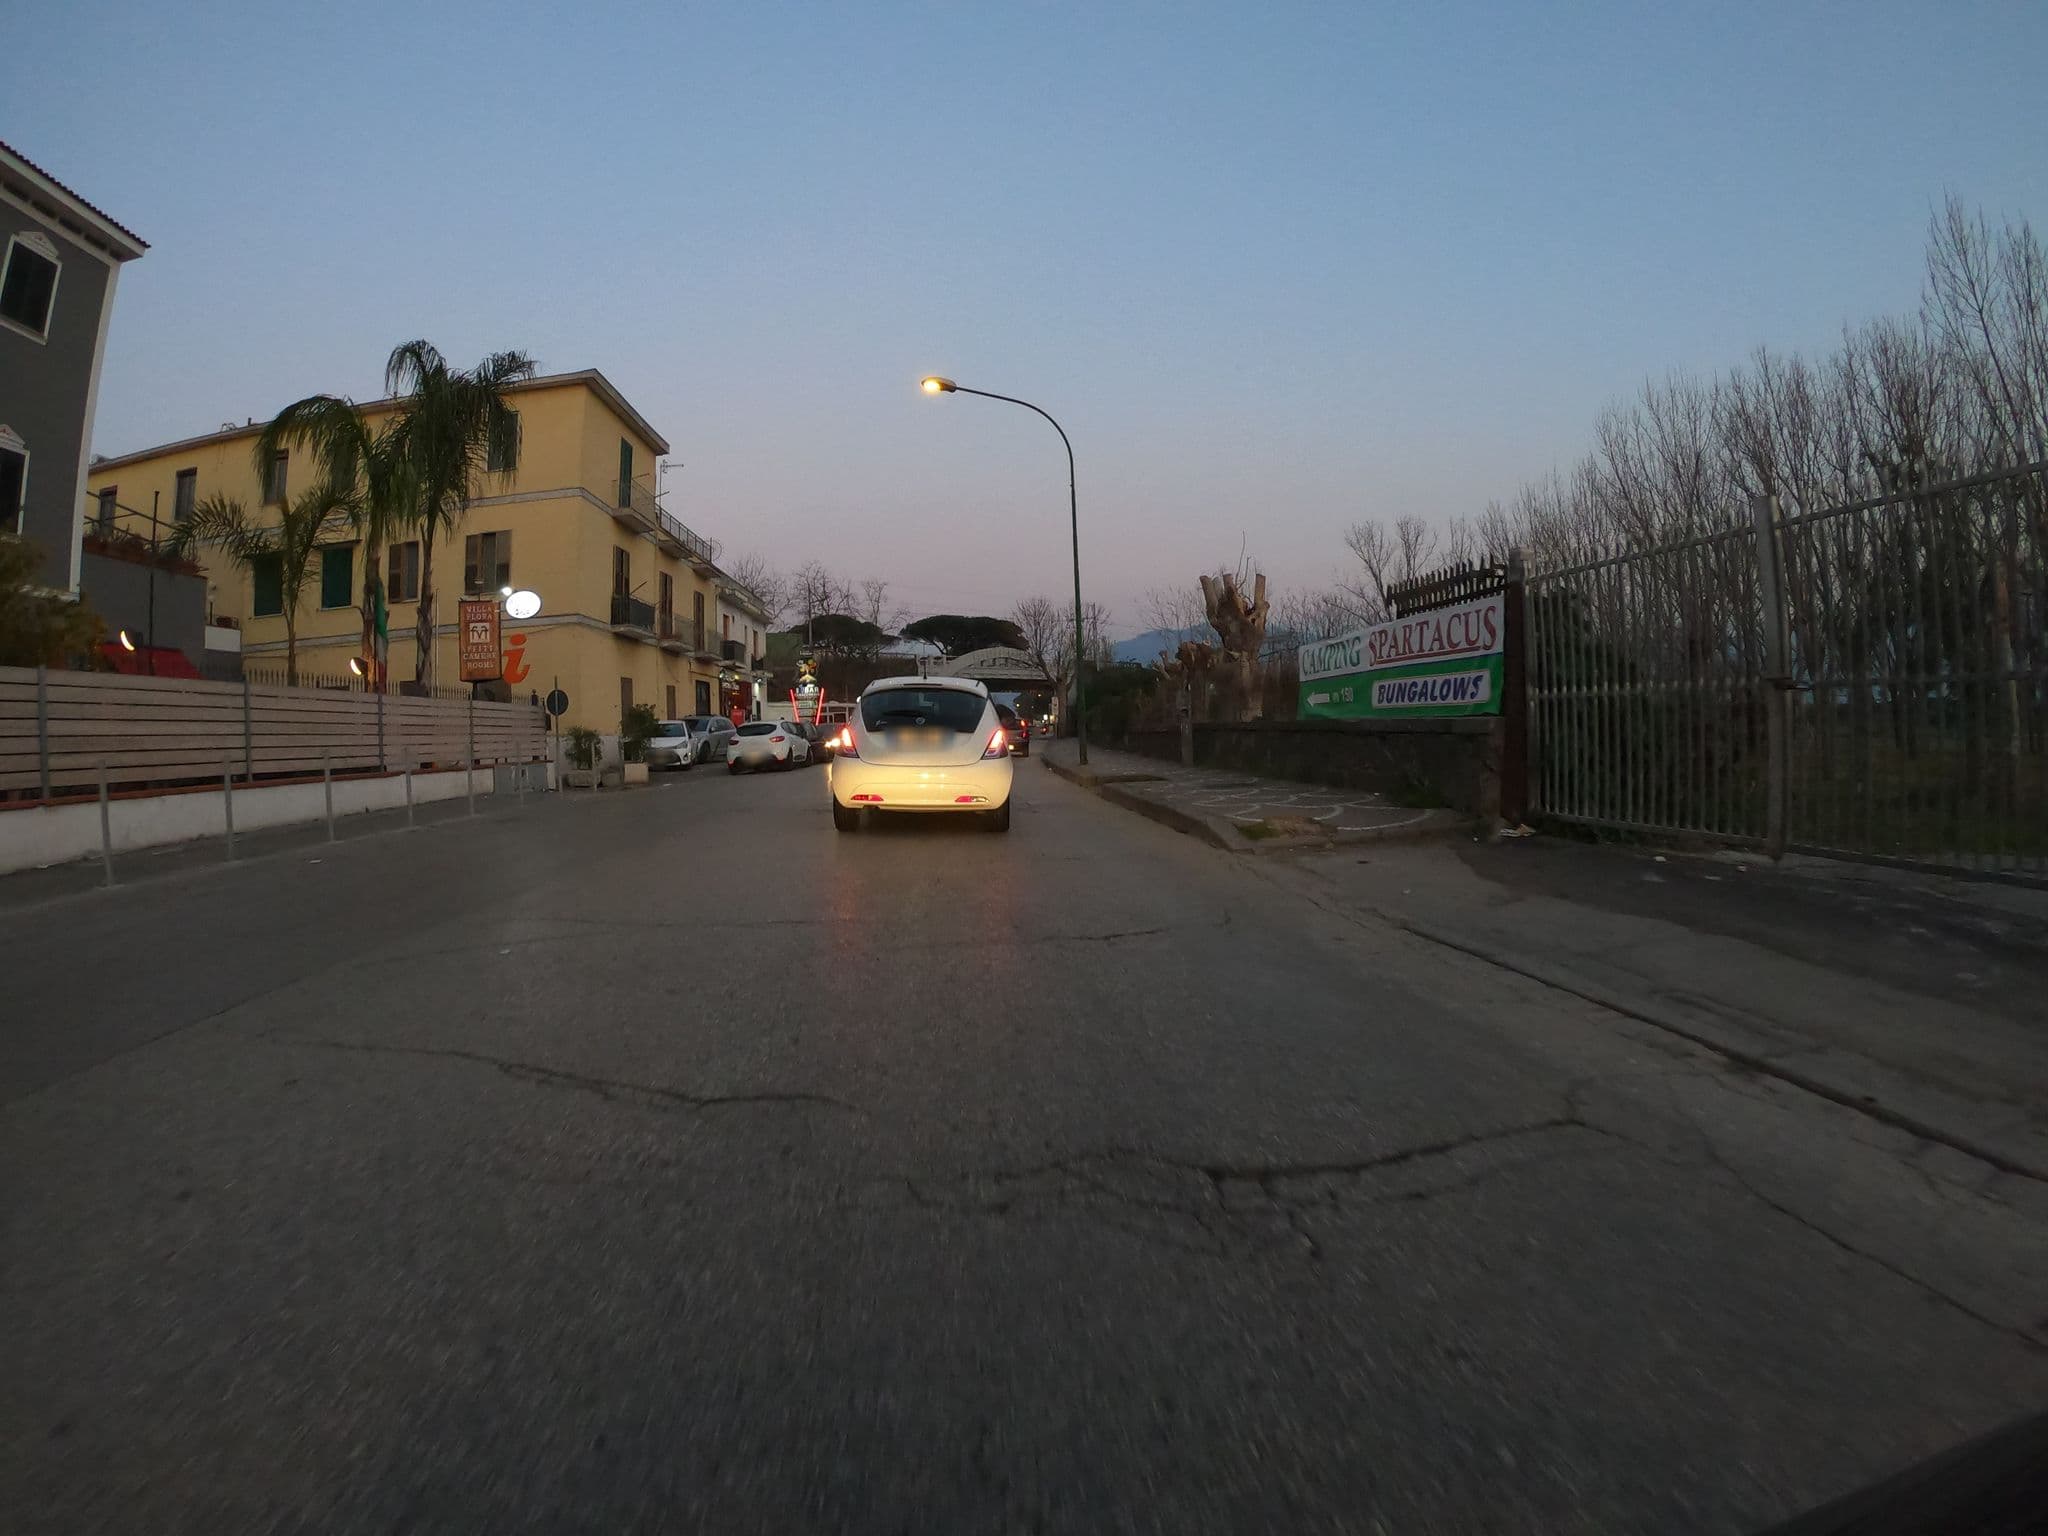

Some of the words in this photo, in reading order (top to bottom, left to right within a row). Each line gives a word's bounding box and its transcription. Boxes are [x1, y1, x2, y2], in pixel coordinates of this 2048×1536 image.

[466, 605, 492, 613] VILLA
[466, 613, 492, 621] FLORA
[1303, 636, 1361, 677] CAMPING
[1368, 605, 1497, 668] SPARTACUS
[1377, 674, 1484, 705] BUNGALOWS
